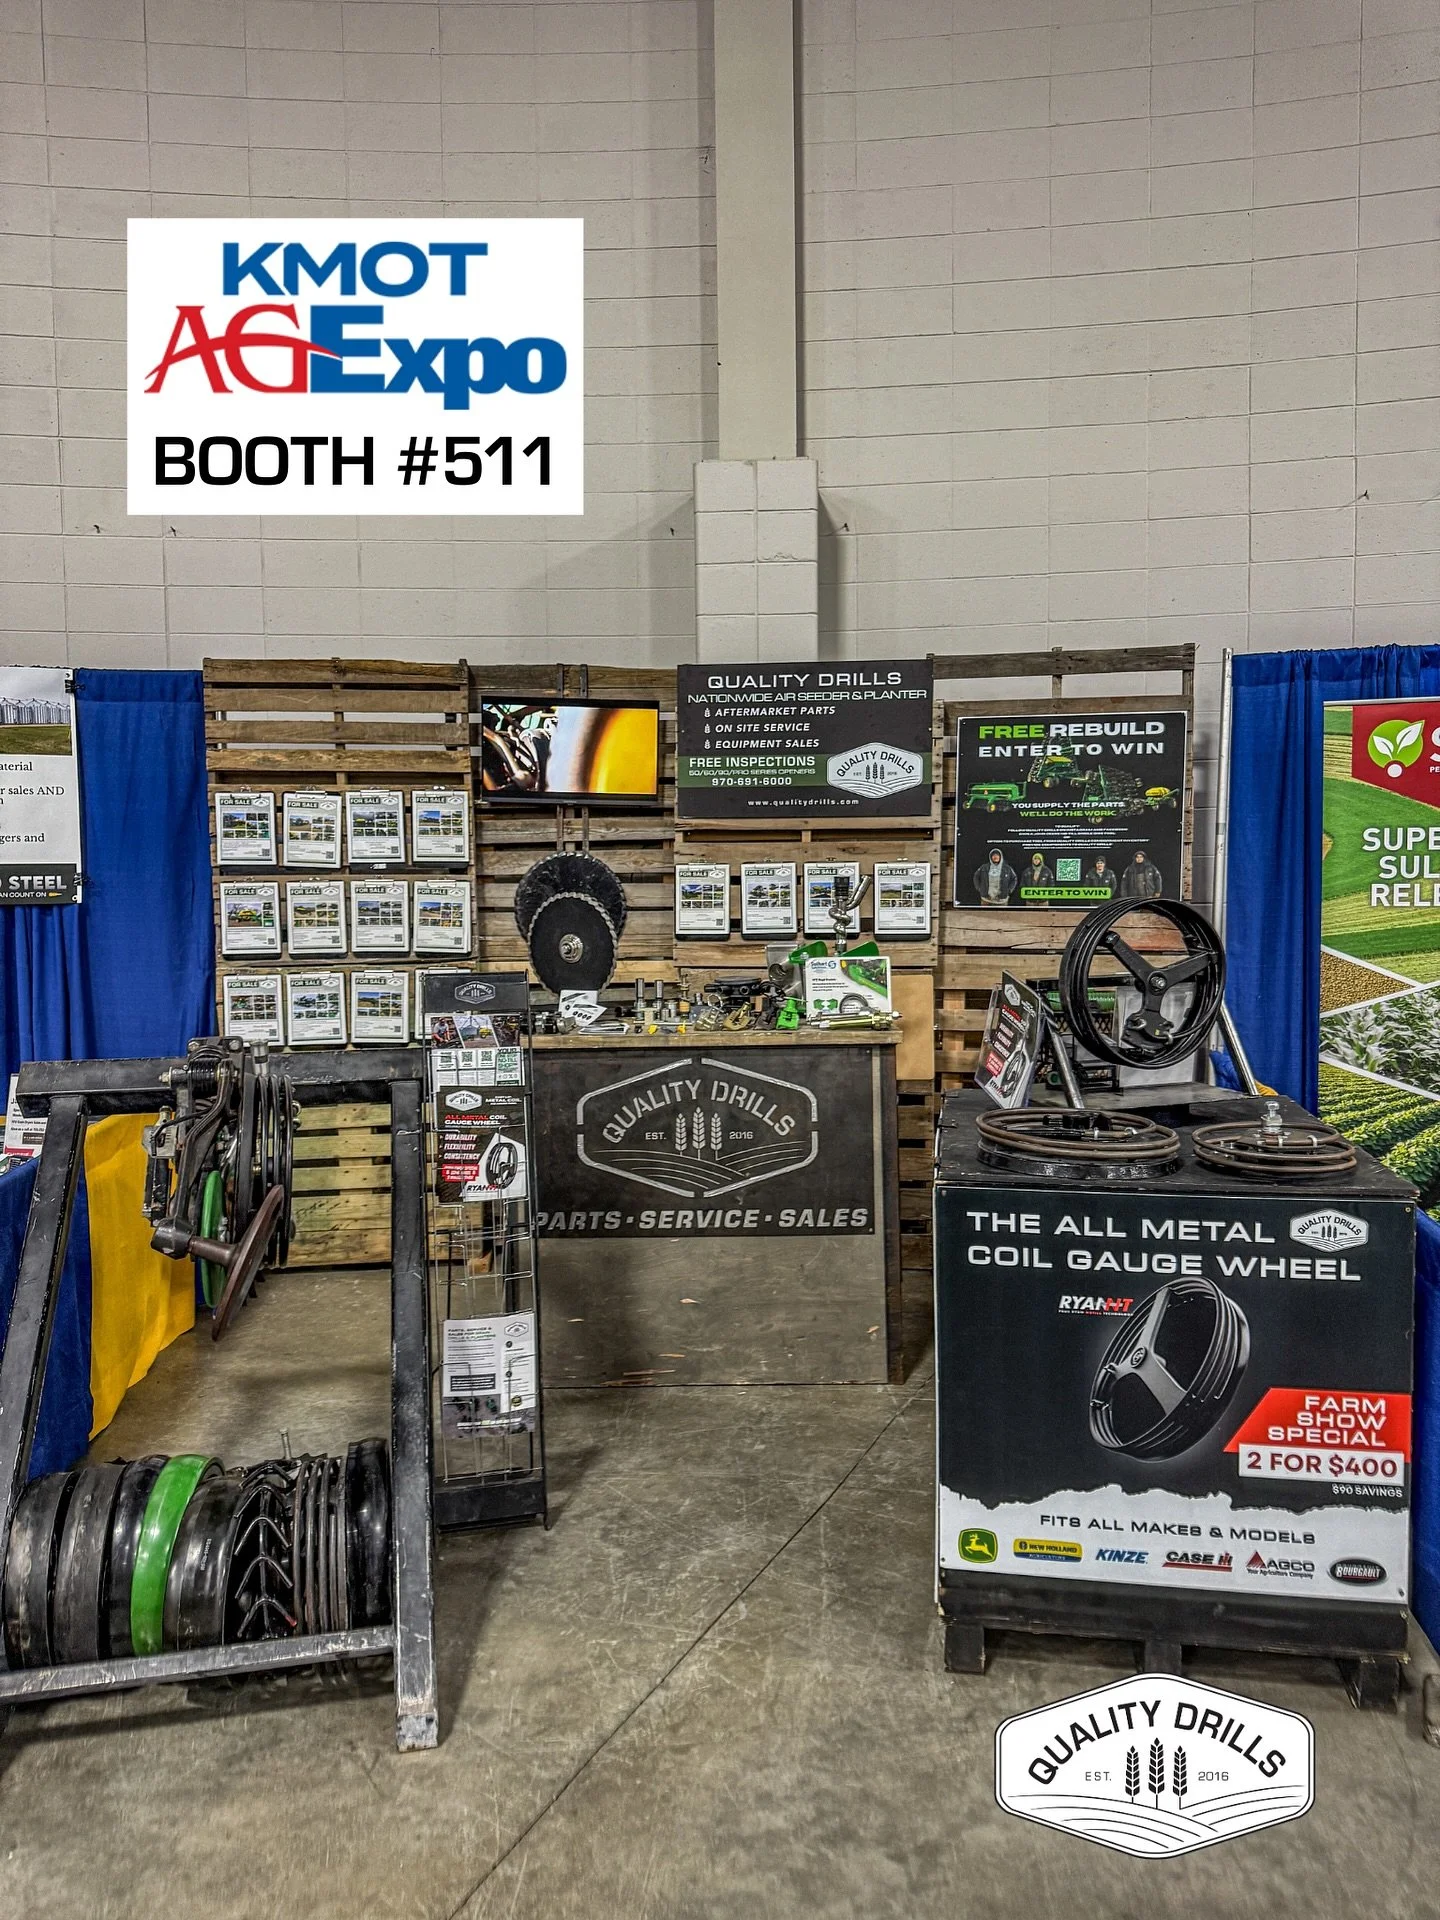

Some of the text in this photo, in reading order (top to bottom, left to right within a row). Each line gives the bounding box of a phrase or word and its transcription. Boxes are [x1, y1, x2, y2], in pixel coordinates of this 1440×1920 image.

[707, 672, 902, 689] QUALITY DRILLS
[687, 690, 927, 704] NATIONWIDE AIR SEEDER & PLANTER
[715, 706, 836, 717] AFTERMARKET PARTS
[715, 723, 810, 733] ON SITE SERVICE
[979, 721, 1166, 740] FREE REBUILD
[715, 738, 820, 749] EQUIPMENT SALES
[978, 742, 1164, 758] ENTER TO WIN
[689, 756, 815, 768] FREE INSPECTIONS
[836, 750, 915, 777] QUALITY DRILLS
[712, 777, 792, 786] 970-691-6000
[8, 785, 34, 795] sales
[37, 786, 65, 796] AND
[747, 798, 859, 807] www.qualitydrills.com
[24, 833, 45, 843] and
[8, 875, 67, 890] STEEL
[1024, 889, 1065, 897] ENTER
[1083, 888, 1108, 896] WIN
[601, 1079, 796, 1145] QUALITY DRILLS
[645, 1130, 753, 1141] EST. 2016
[638, 1209, 759, 1229] SERVICE
[778, 1208, 869, 1227] SALES
[1297, 1215, 1362, 1236] QUALITY DRILLS
[966, 1211, 1275, 1244] THE ALL METAL
[966, 1245, 1361, 1281] COIL GAUGE WHEEL
[1304, 1395, 1386, 1414] FARM
[1296, 1411, 1387, 1430] SHOW
[1267, 1426, 1386, 1447] SPECIAL
[1247, 1452, 1397, 1477] 2 FOR $400
[1332, 1485, 1402, 1498] $90 SAVINGS
[1040, 1515, 1315, 1544] FITS ALL MAKES & MODELS
[1046, 1545, 1077, 1553] HOLLAND
[1166, 1551, 1214, 1564] CASE
[1264, 1559, 1315, 1572] AGCO
[1335, 1564, 1380, 1578] BOURGAULT
[1289, 1571, 1314, 1580] Company
